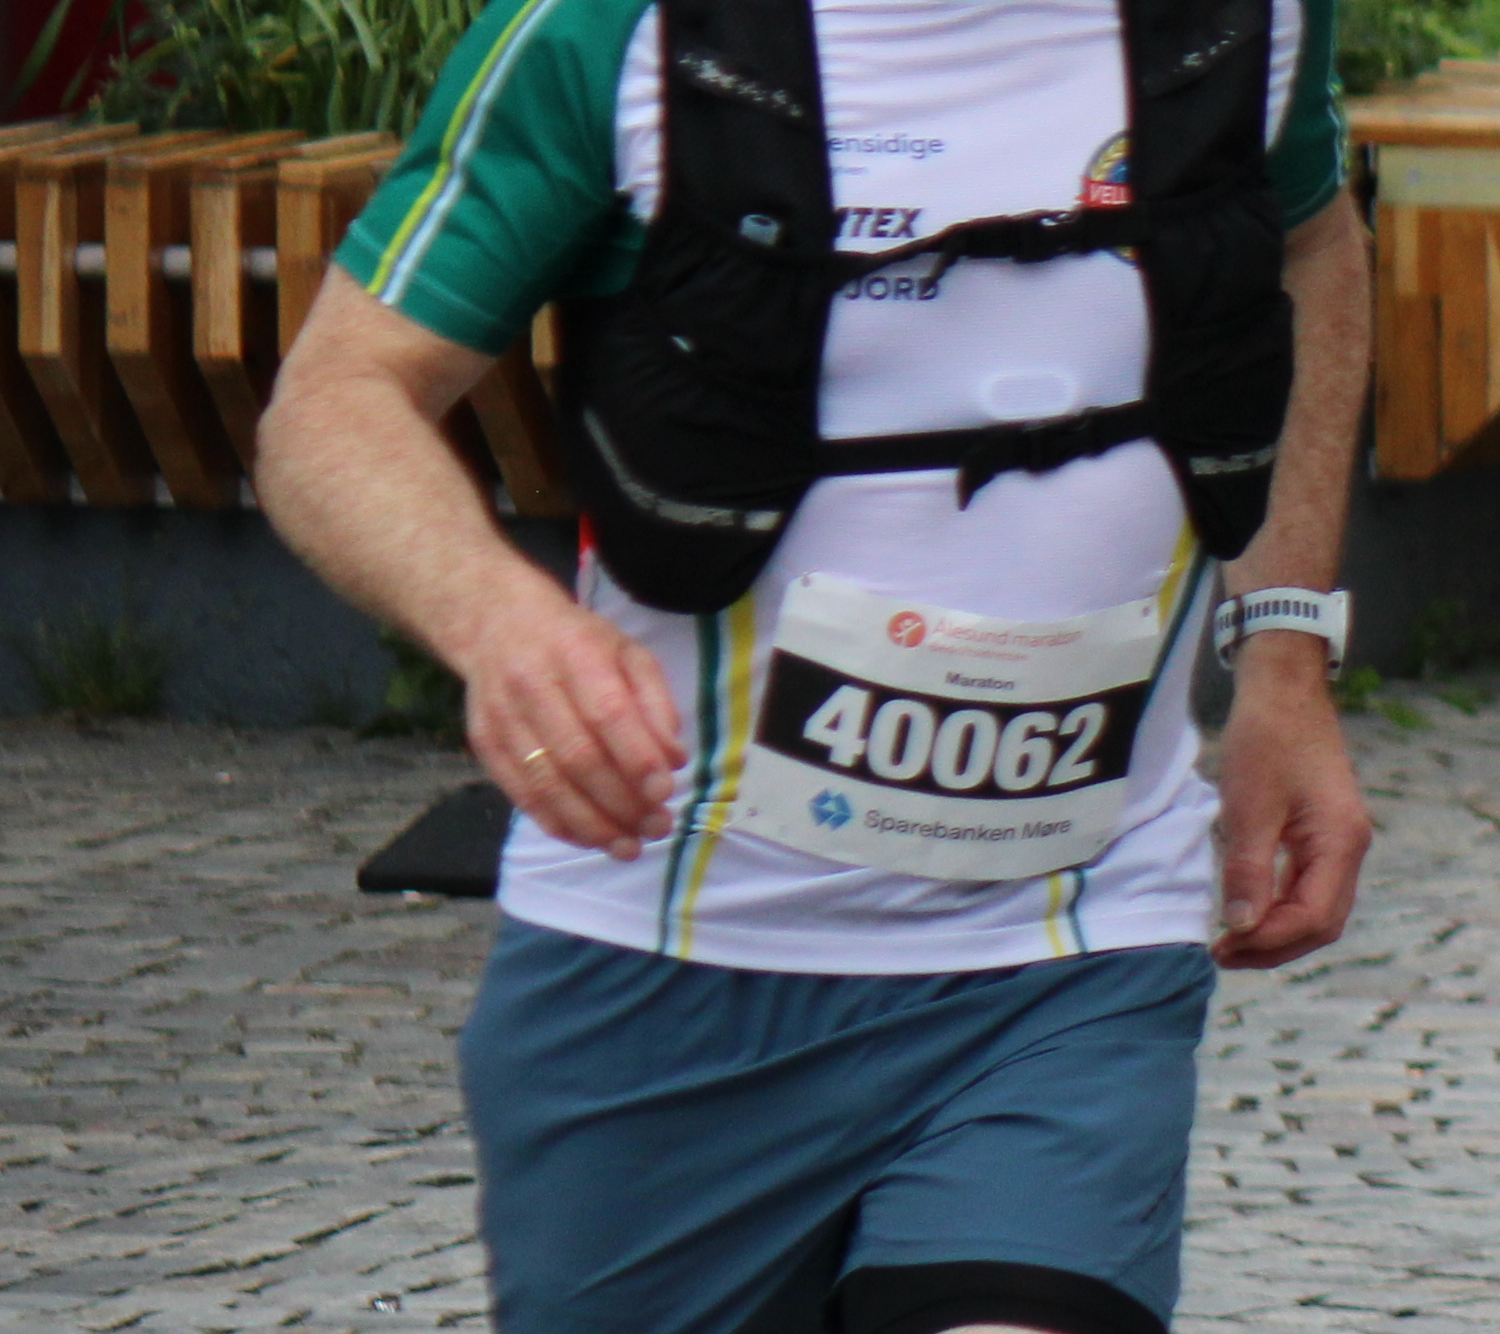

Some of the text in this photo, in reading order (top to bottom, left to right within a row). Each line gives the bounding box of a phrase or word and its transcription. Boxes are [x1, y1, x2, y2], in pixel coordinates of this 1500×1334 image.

[944, 671, 1015, 691] Maraton
[803, 683, 1107, 792] 40062
[863, 808, 1072, 842] Sparebanken Møre
